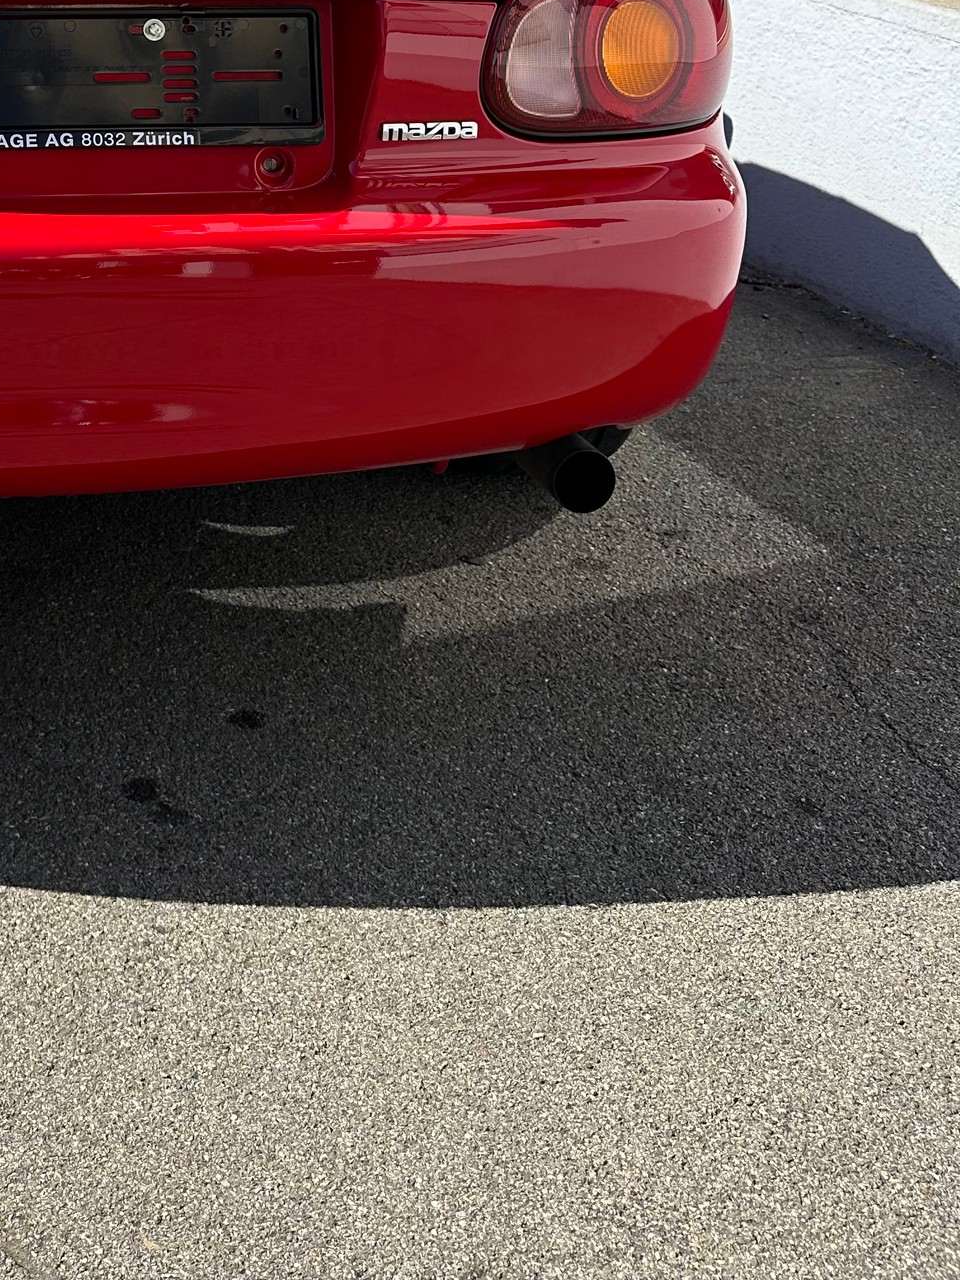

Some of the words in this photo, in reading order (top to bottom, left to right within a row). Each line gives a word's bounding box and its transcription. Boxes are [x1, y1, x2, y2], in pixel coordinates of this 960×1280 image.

[45, 132, 74, 147] AG
[81, 132, 126, 146] 8032
[132, 131, 195, 146] Zürich
